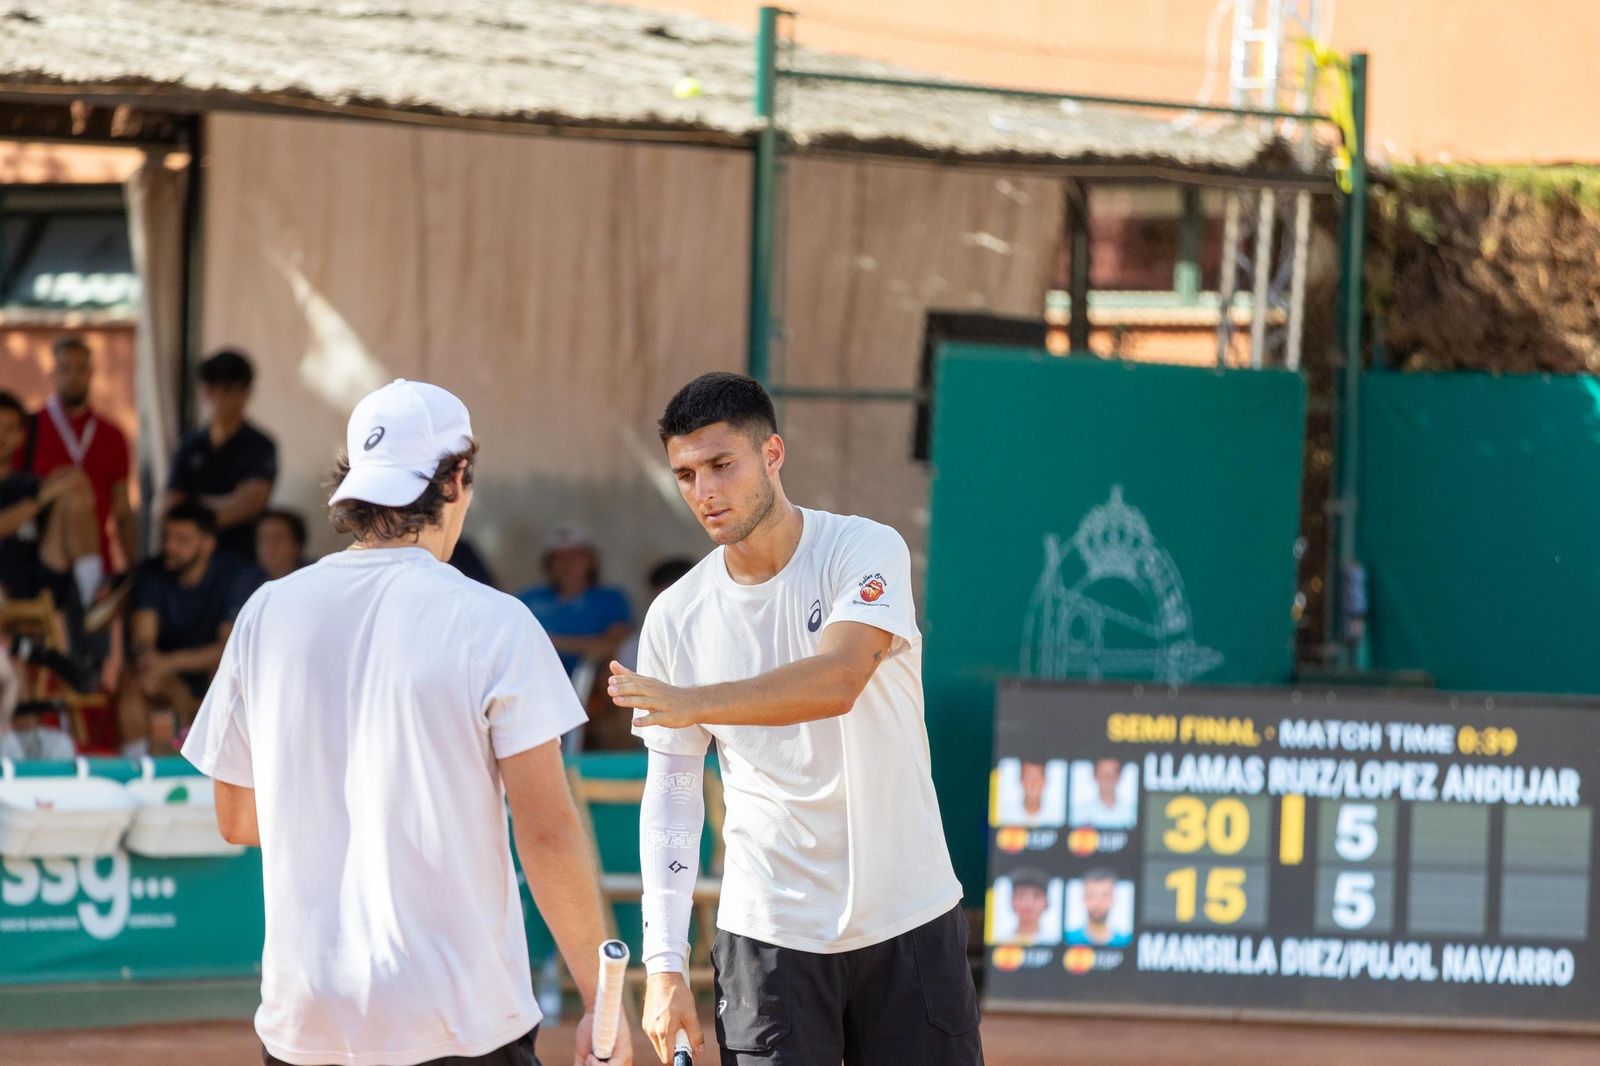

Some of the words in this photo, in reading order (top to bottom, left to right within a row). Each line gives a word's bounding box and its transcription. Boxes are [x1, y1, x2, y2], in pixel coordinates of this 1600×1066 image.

[1107, 712, 1178, 743] SEMI
[1180, 714, 1261, 747] FINAL
[1279, 718, 1382, 752] MATCH
[1384, 722, 1456, 754] TIME
[1143, 752, 1265, 794] LLAMAS
[1441, 763, 1580, 807] ANDUJAR
[1163, 796, 1249, 855] 30
[1334, 803, 1378, 862] 5
[1165, 867, 1248, 925] 15
[1332, 871, 1376, 930] 5
[1137, 932, 1278, 975] MANSILLA
[1441, 943, 1575, 987] NAVARRO
